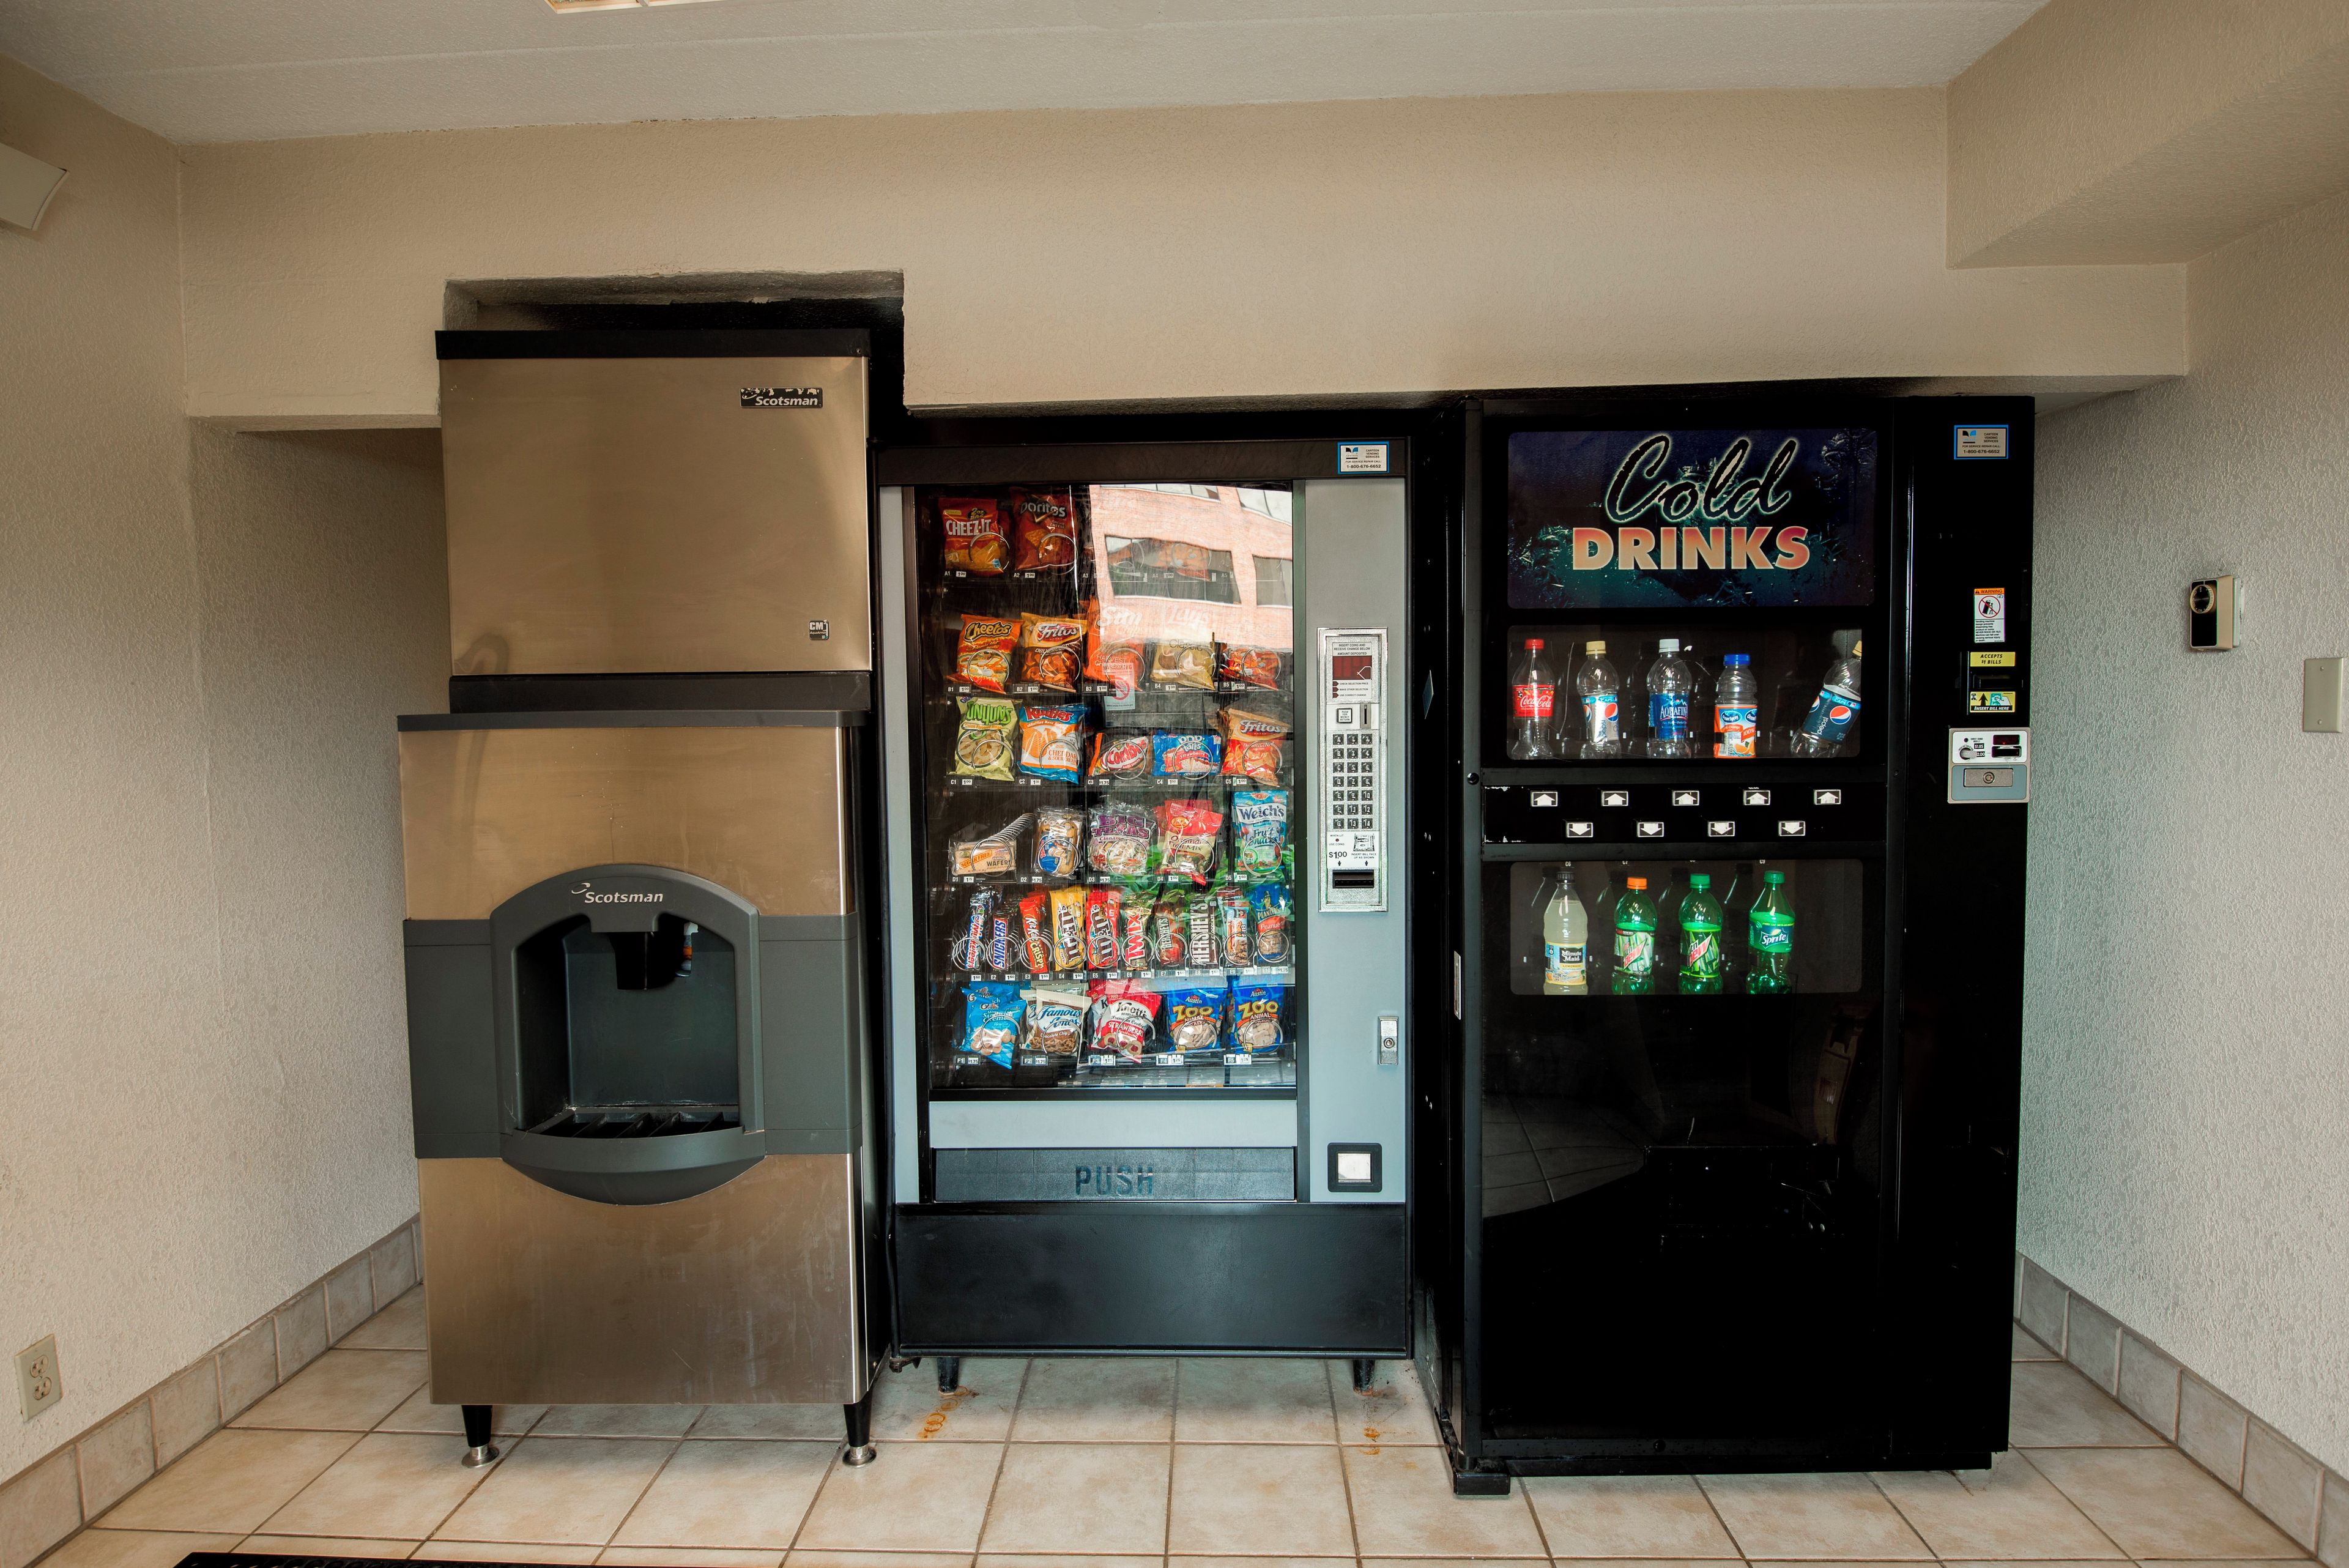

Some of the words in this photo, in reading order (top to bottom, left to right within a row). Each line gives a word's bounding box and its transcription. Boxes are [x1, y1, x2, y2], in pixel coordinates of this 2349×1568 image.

[755, 396, 818, 406] Scotsman
[1606, 434, 1798, 522] Cold
[1020, 502, 1066, 518] Doritos
[946, 519, 991, 536] CHEEZ-IT
[1572, 526, 1810, 570] DRINKS
[964, 622, 1012, 641] Cheetos
[1038, 623, 1077, 641] Fritos
[1240, 720, 1282, 733] Fritos
[1817, 717, 1829, 735] pepsi
[1238, 805, 1285, 820] Welch's
[1098, 814, 1143, 828] BIG
[1091, 824, 1149, 839] TEXAS
[1254, 827, 1274, 836] Fruit
[978, 852, 991, 860] FREE
[584, 891, 663, 904] Scotsman
[1126, 914, 1145, 964] TWIX
[1190, 903, 1210, 964] HERSHEY'S
[1762, 933, 1786, 946] Sprite
[994, 920, 1007, 968] SNICKERS
[1030, 943, 1044, 968] CRISPY
[1185, 996, 1202, 1004] Austin
[1037, 1006, 1081, 1020] Famous
[1116, 1002, 1147, 1017] Knott's
[1173, 1005, 1214, 1021] ZOO
[1238, 1001, 1278, 1020] ZOO
[1075, 1165, 1154, 1196] PUSH
